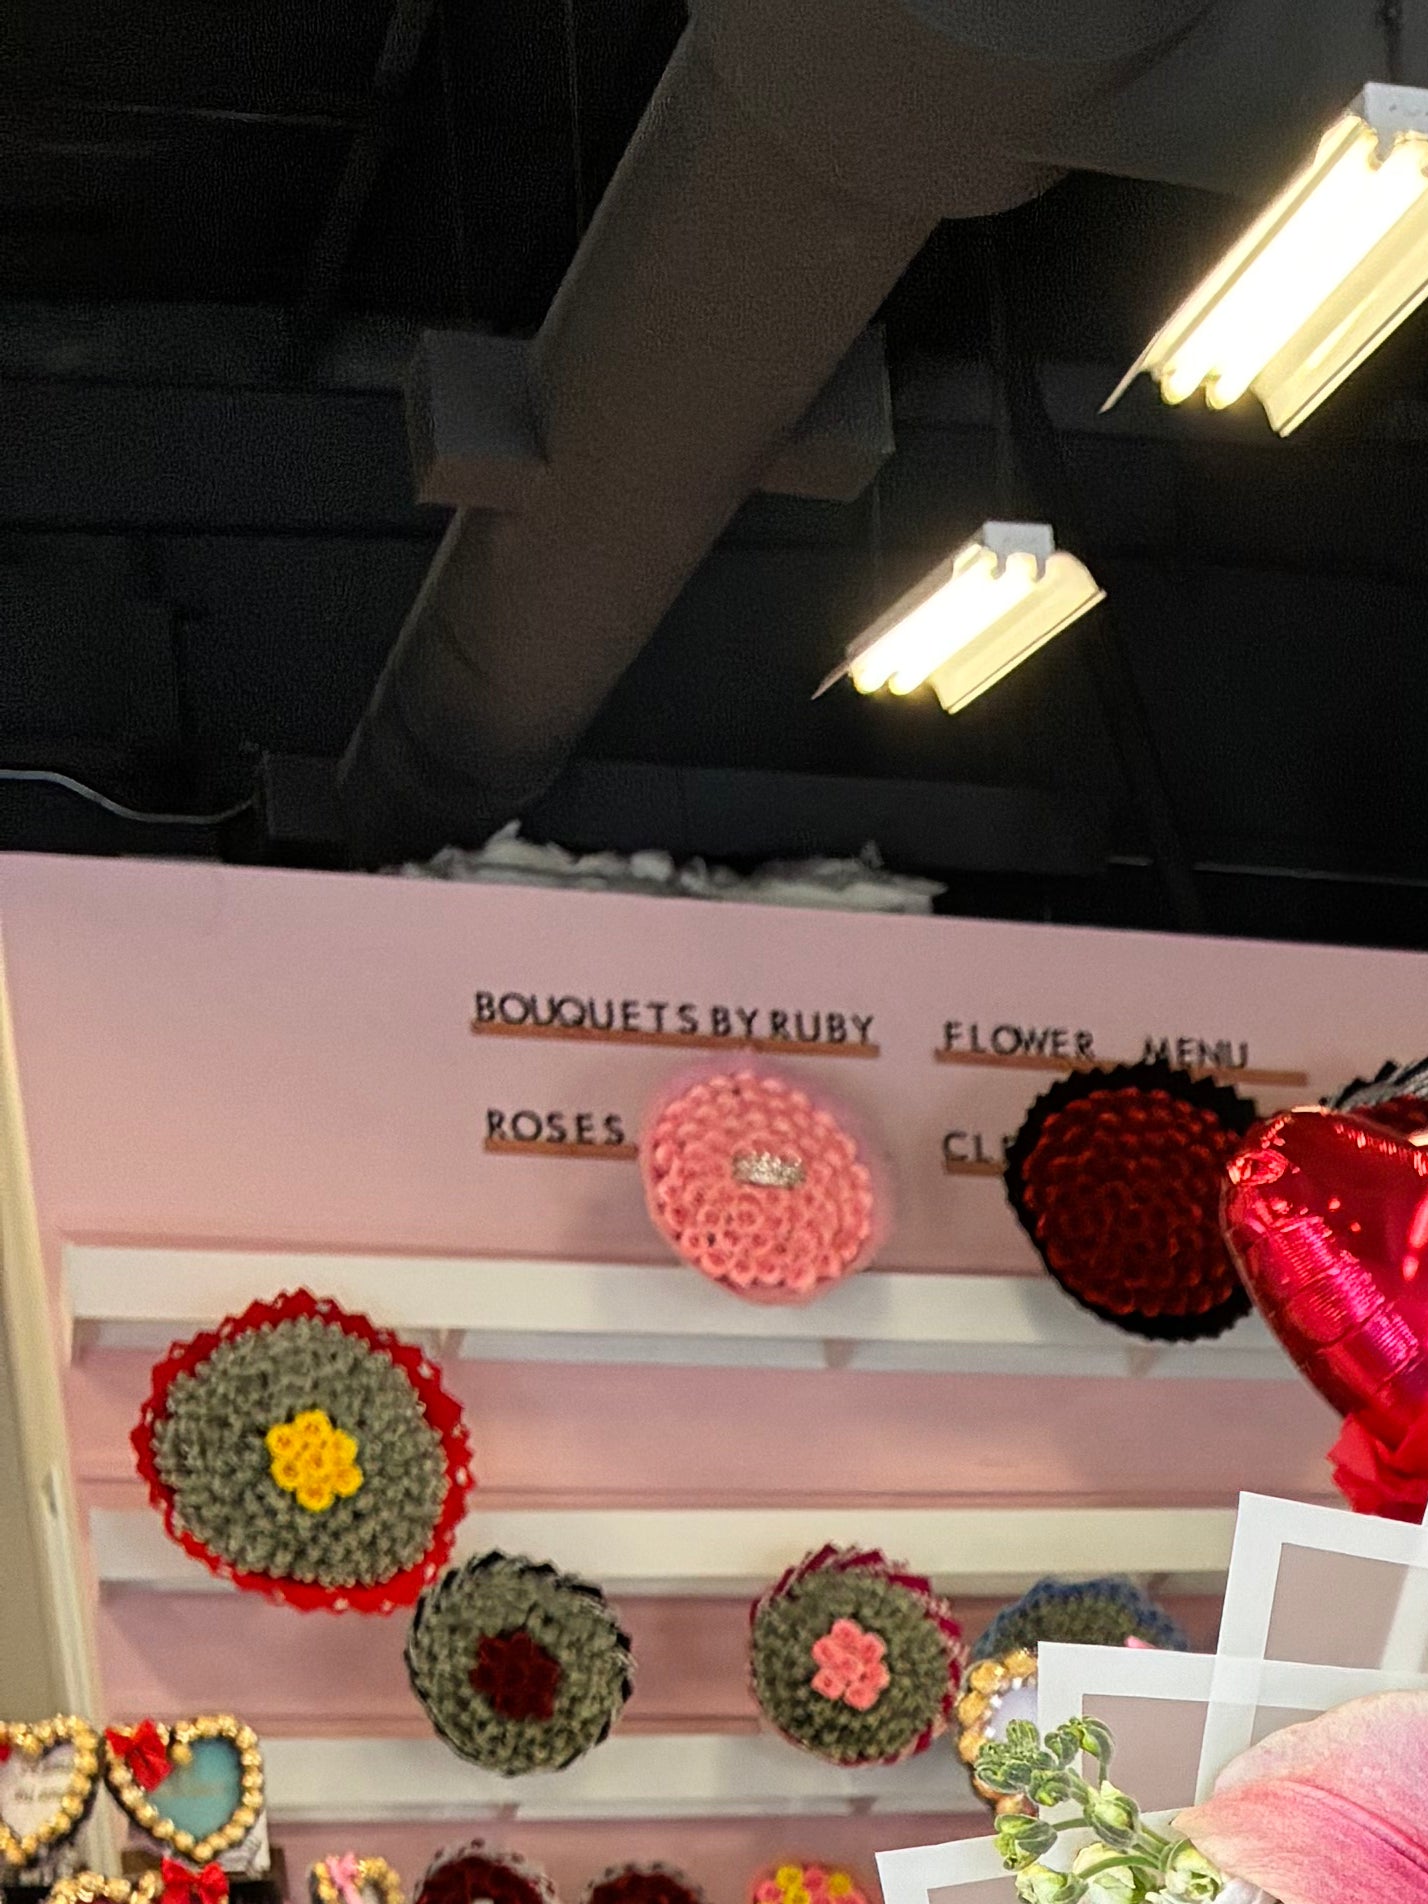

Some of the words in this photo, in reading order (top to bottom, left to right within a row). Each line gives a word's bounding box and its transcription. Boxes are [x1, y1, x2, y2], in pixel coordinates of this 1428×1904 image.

[475, 990, 699, 1035] BOUQUETS
[768, 1008, 875, 1045] RUBY
[942, 1020, 1097, 1060] FLOWER
[1143, 1035, 1249, 1069] MENU
[486, 1107, 627, 1146] ROSES
